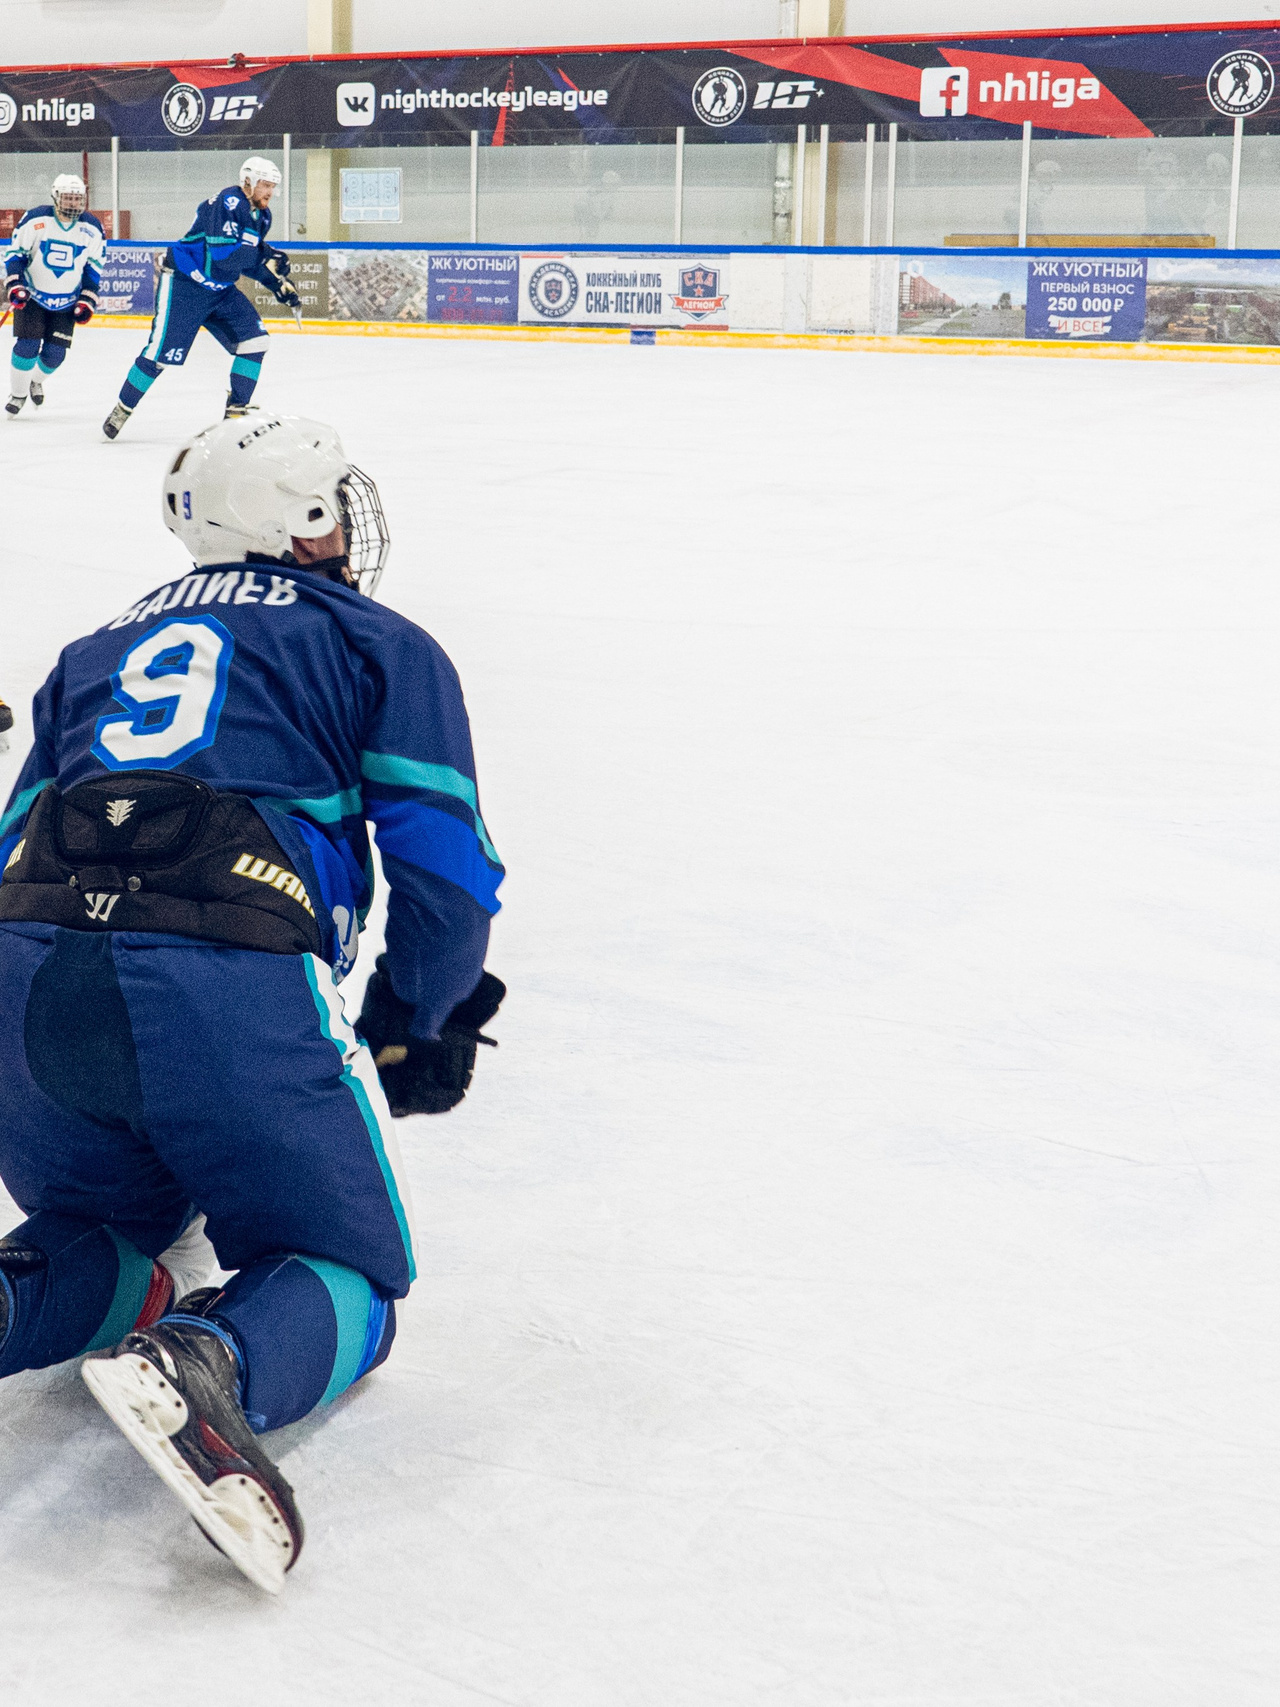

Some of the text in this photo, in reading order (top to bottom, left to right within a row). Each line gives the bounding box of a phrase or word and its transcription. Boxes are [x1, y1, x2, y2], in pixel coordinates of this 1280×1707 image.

[979, 71, 1100, 108] nhliga
[380, 85, 608, 114] nighthockeyleague
[21, 98, 96, 126] nhliga
[105, 252, 152, 264] СРОЧКА
[431, 257, 517, 271] ЖК УЮТНЫЙ
[118, 269, 147, 278] ВЗНОС
[1032, 260, 1144, 278] ЖК УЮТНЫЙ
[586, 270, 662, 288] ХОККЕЙНЫЙ КЛУБ
[683, 271, 715, 287] СКА
[1040, 281, 1135, 295] ПЕРВЫЙ ВЗНОС
[586, 291, 662, 314] СКА-ЛЕГИОН
[683, 300, 715, 310] ЛЕГИОН
[1047, 297, 1077, 312] 250
[1057, 320, 1105, 332] И ВСЕ!
[165, 348, 184, 362] 45
[238, 420, 282, 449] CCM
[90, 613, 235, 771] 9
[231, 853, 316, 919] WAR
